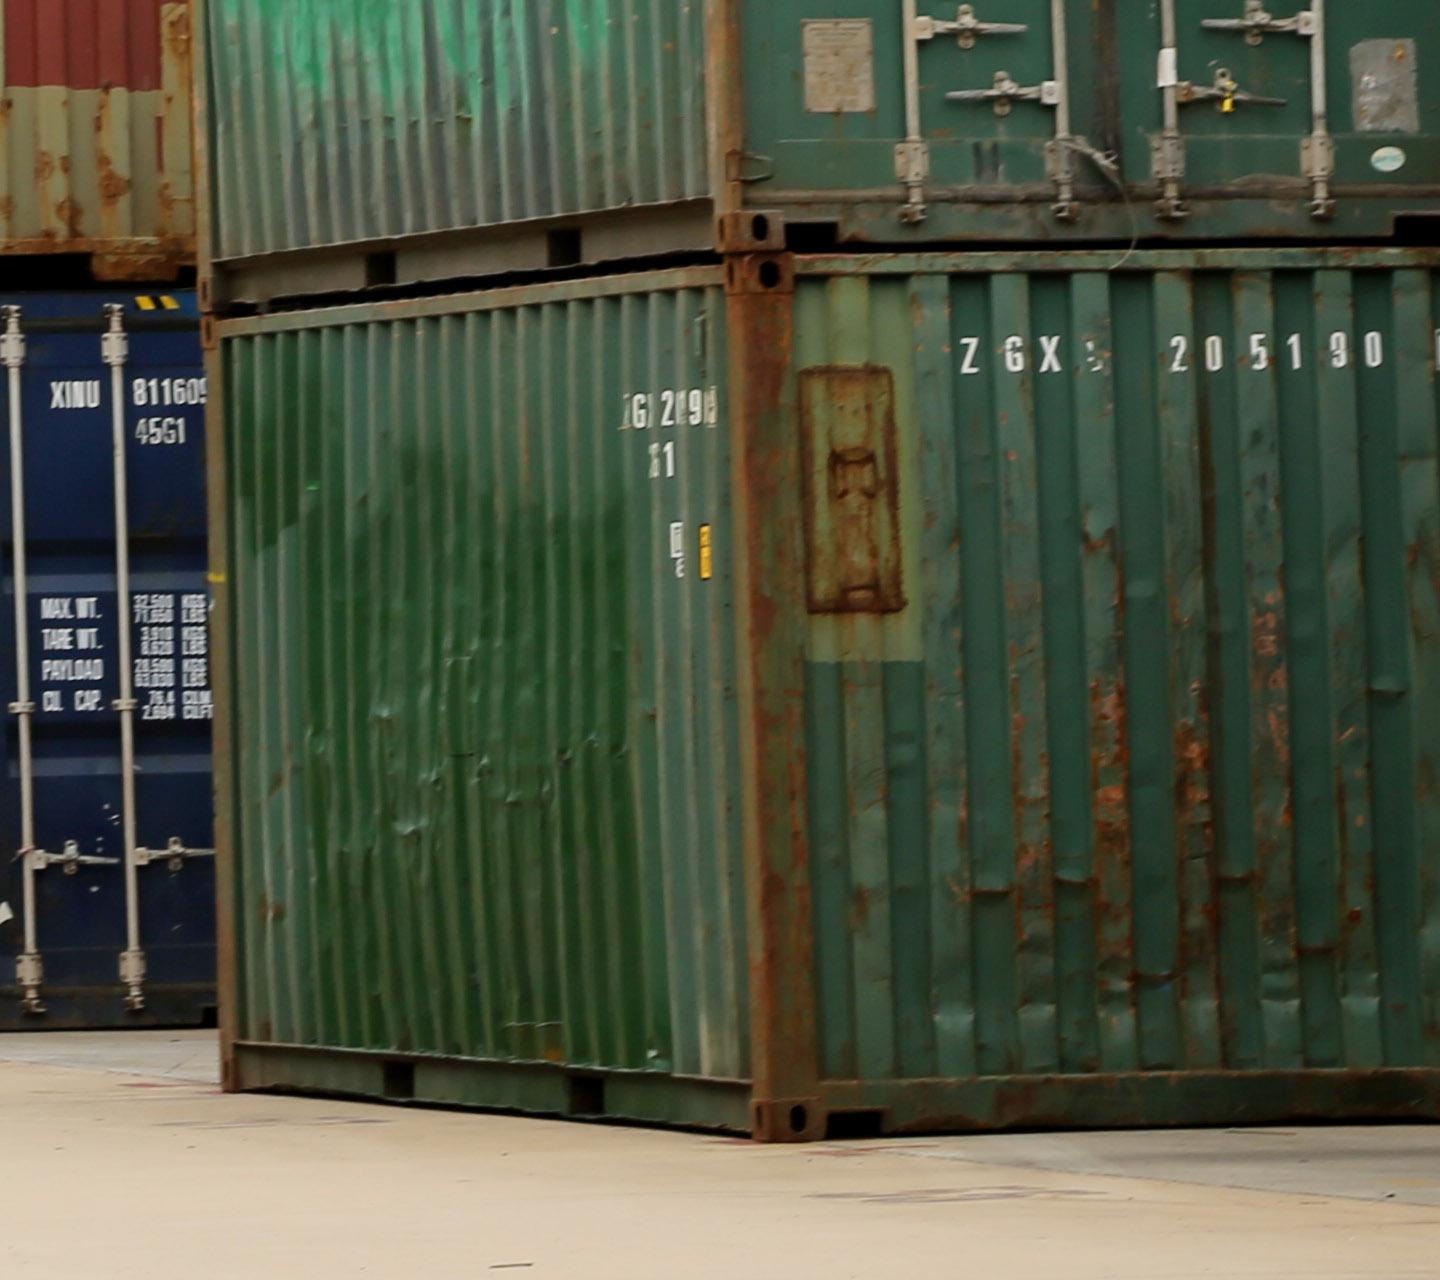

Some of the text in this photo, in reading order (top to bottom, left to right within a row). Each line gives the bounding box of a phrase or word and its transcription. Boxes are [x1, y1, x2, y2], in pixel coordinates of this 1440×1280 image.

[50, 380, 101, 409] XINU
[135, 417, 187, 445] 45G1
[41, 658, 105, 681] PAYLOAD
